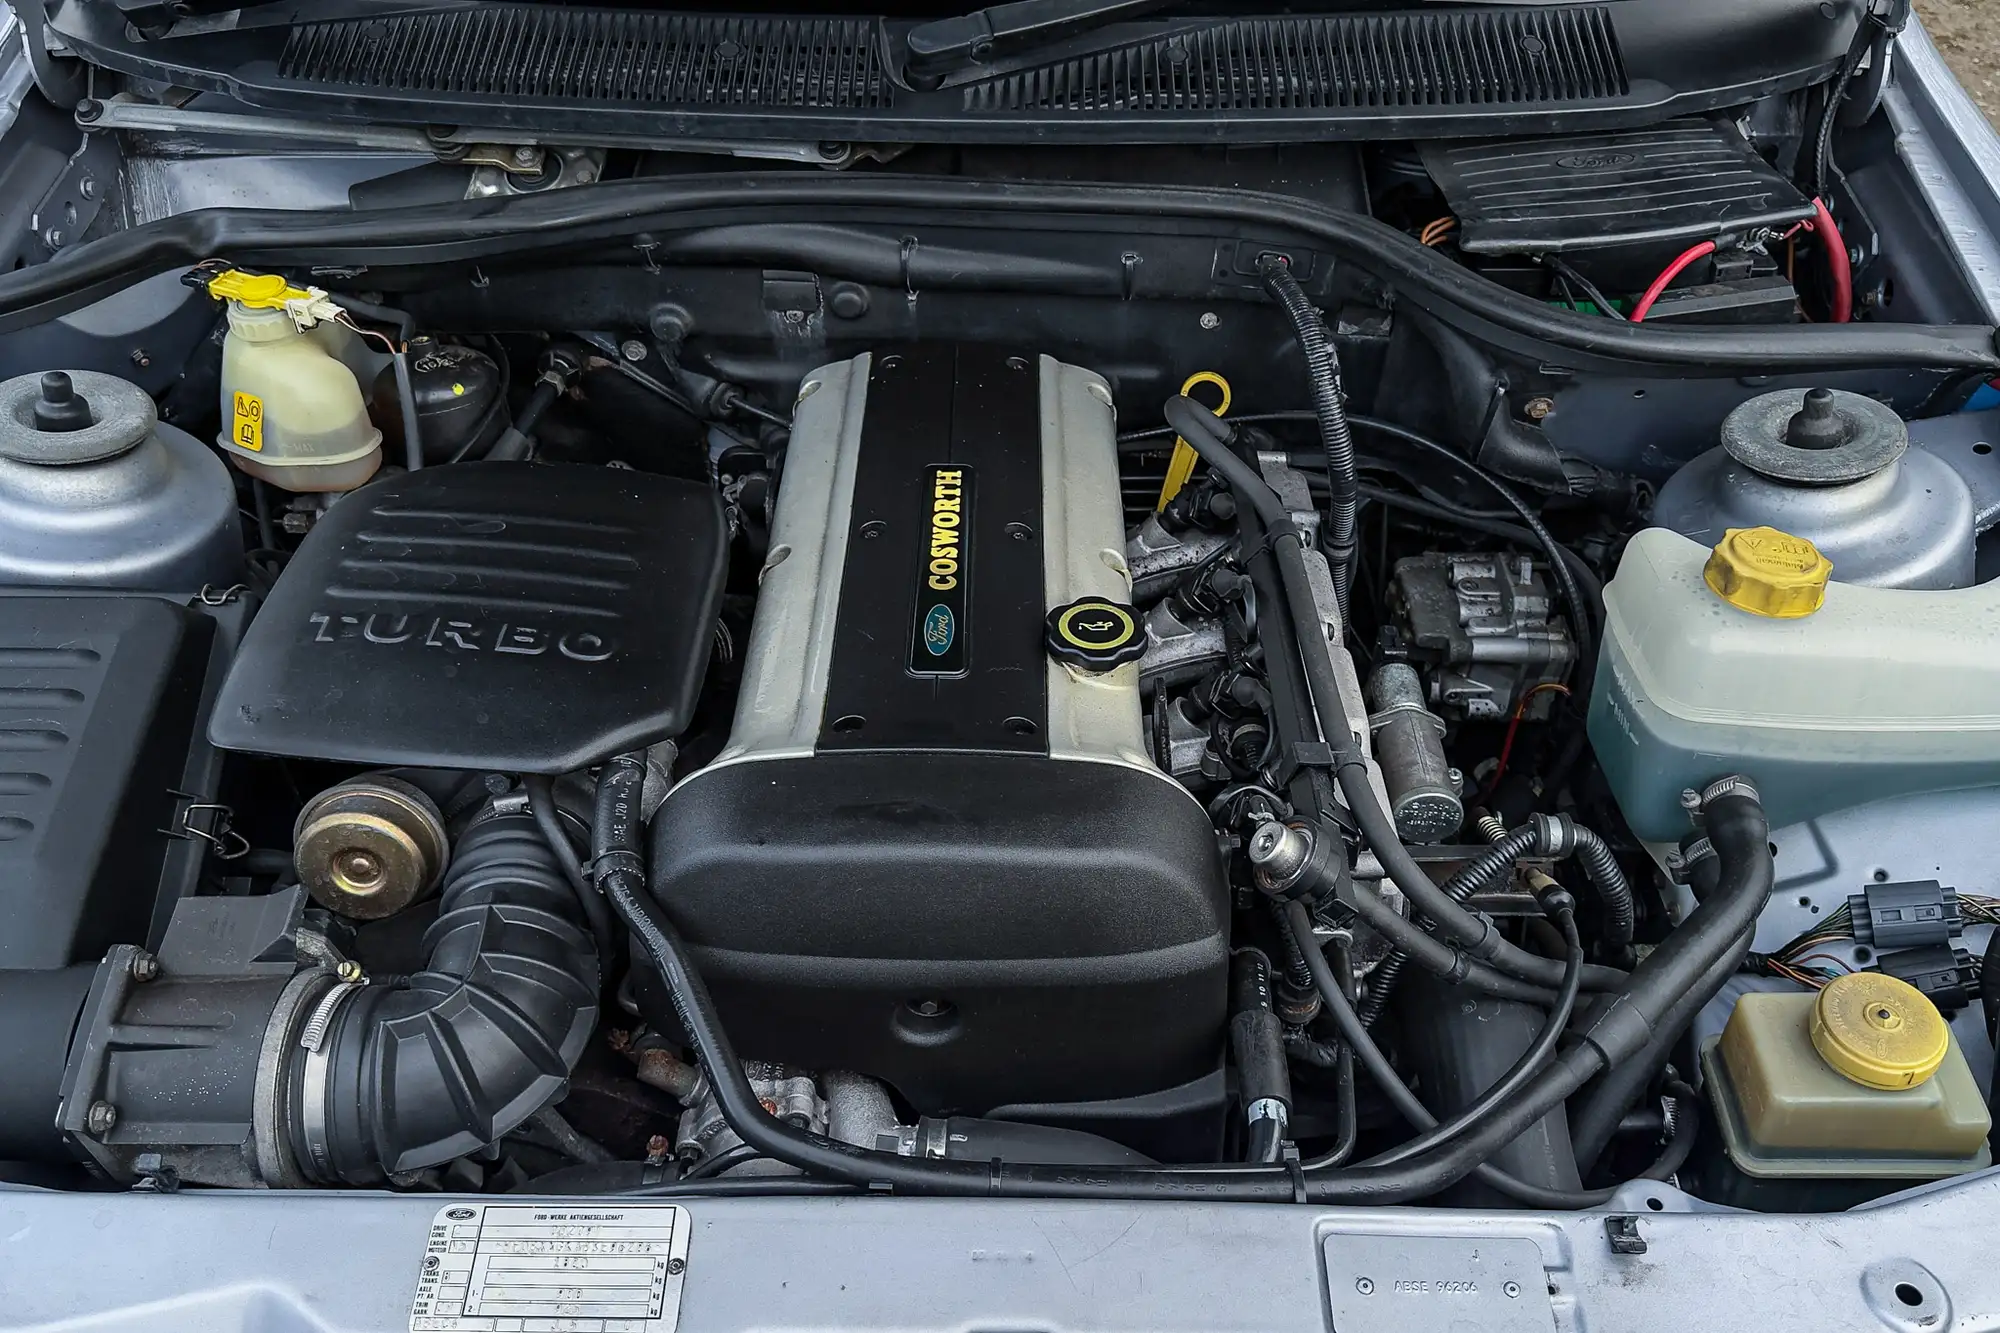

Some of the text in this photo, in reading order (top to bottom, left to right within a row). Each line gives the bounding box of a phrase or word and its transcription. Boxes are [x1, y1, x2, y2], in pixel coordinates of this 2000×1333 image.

[928, 470, 962, 590] COSWORTH
[309, 612, 614, 662] TURBO
[657, 1261, 665, 1270] kg
[655, 1276, 662, 1285] kg
[1394, 1280, 1478, 1294] ABSE 96206
[652, 1291, 660, 1300] kg
[650, 1307, 658, 1316] kg
